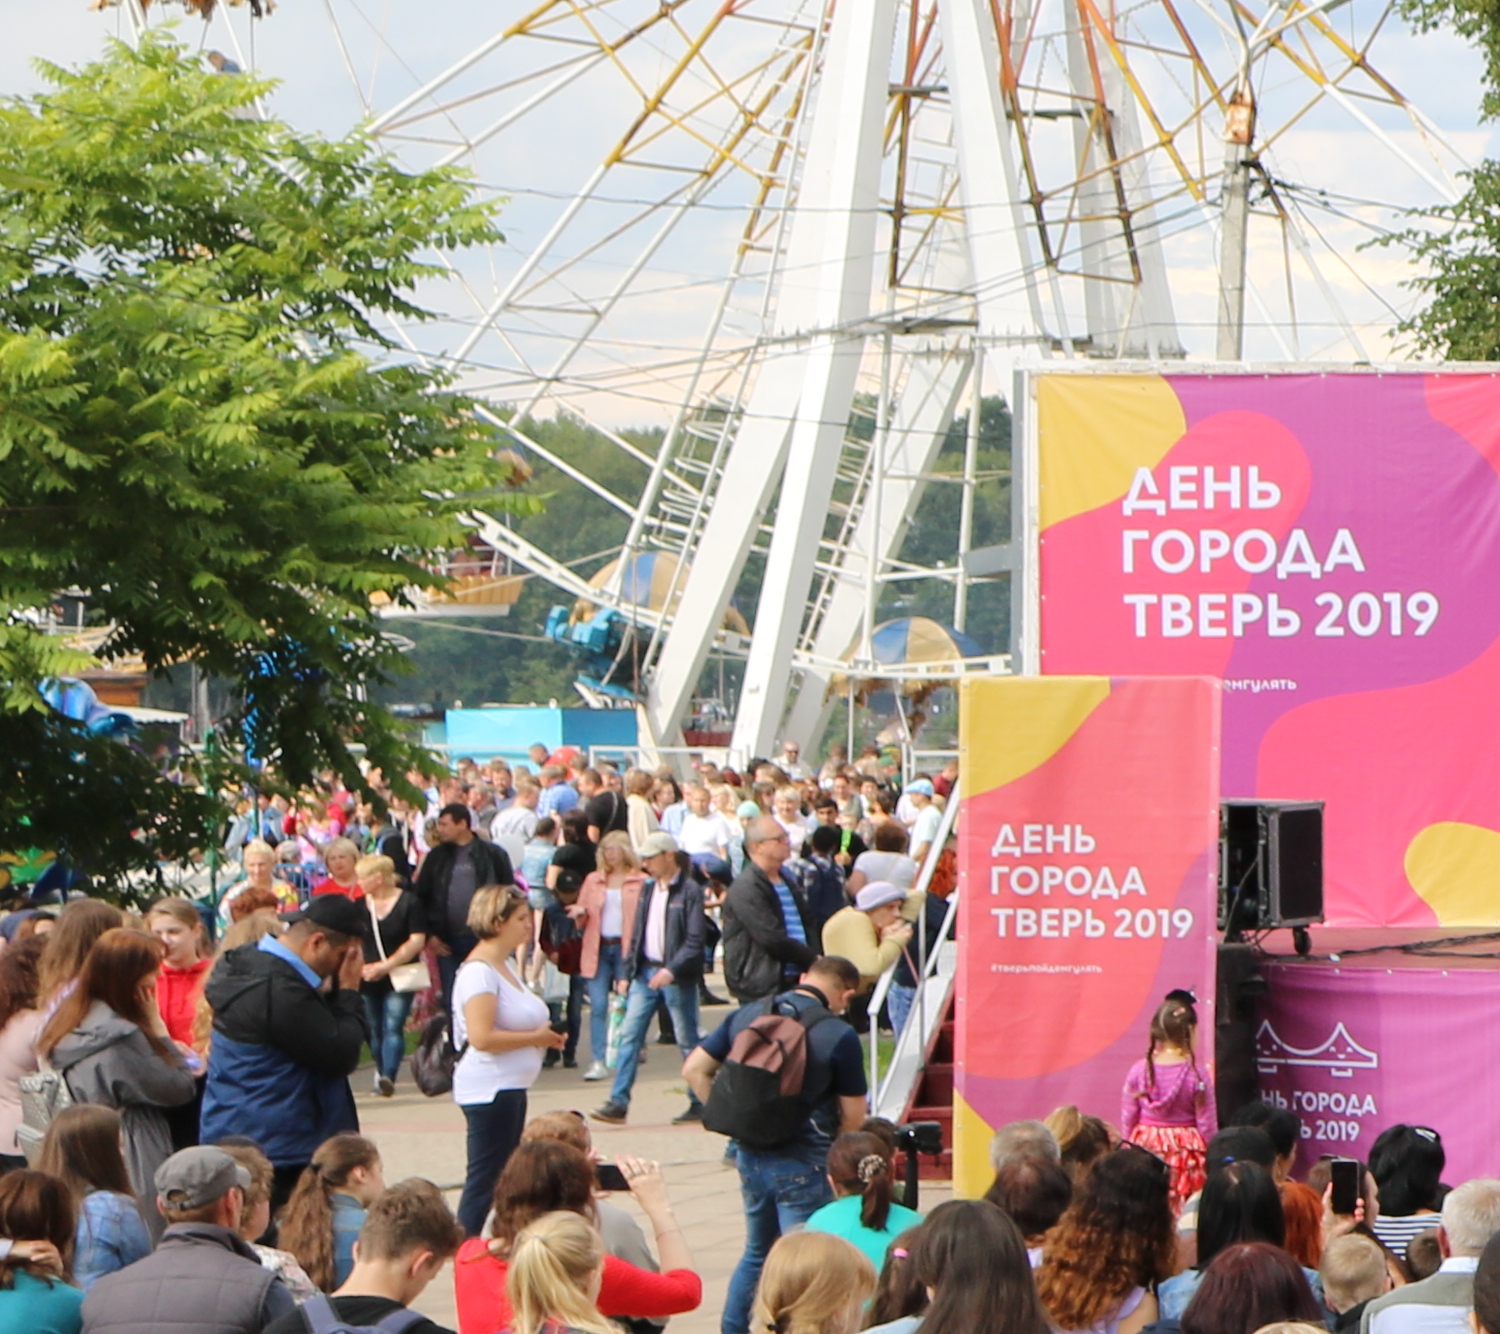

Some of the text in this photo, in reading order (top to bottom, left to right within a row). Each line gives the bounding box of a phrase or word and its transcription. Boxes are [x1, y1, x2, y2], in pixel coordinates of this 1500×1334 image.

[1121, 465, 1282, 516] ДЕНЬ
[1122, 528, 1365, 580] ГОРОДА
[1123, 591, 1439, 638] ТВЕРЬ 2019
[991, 823, 1096, 858] ДЕНЬ
[991, 865, 1147, 900] ГОРОДА
[990, 908, 1193, 938] ТВЕРЬ 2019
[1292, 1091, 1378, 1117] ГОРОДА
[1316, 1120, 1360, 1142] 2019
